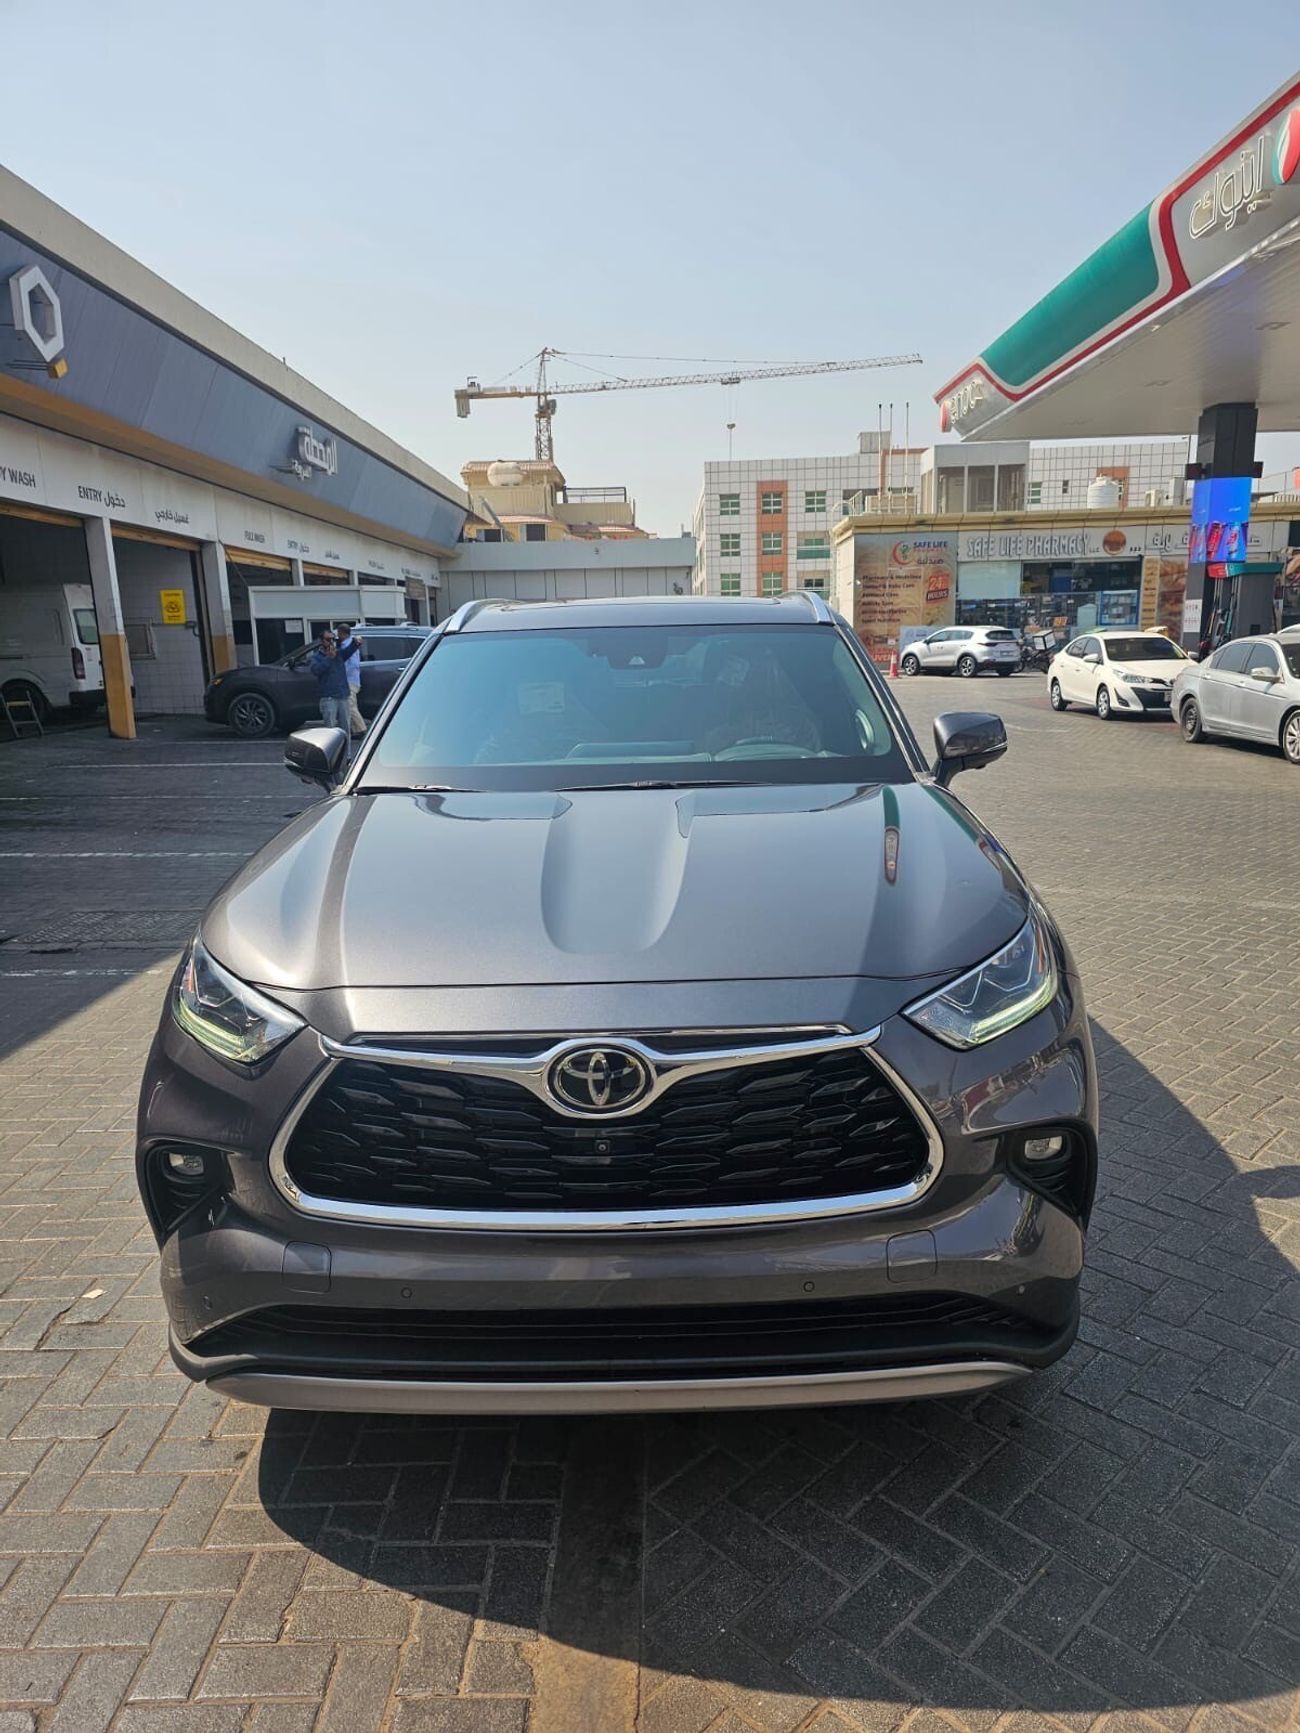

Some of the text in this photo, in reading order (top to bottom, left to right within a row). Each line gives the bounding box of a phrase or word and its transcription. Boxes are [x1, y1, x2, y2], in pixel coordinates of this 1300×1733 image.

[8, 467, 36, 488] WASH
[78, 486, 126, 508] ENTRY دخول
[968, 536, 994, 557] SAFE
[1001, 535, 1023, 557] LIFE
[1026, 534, 1089, 557] PHARMACY
